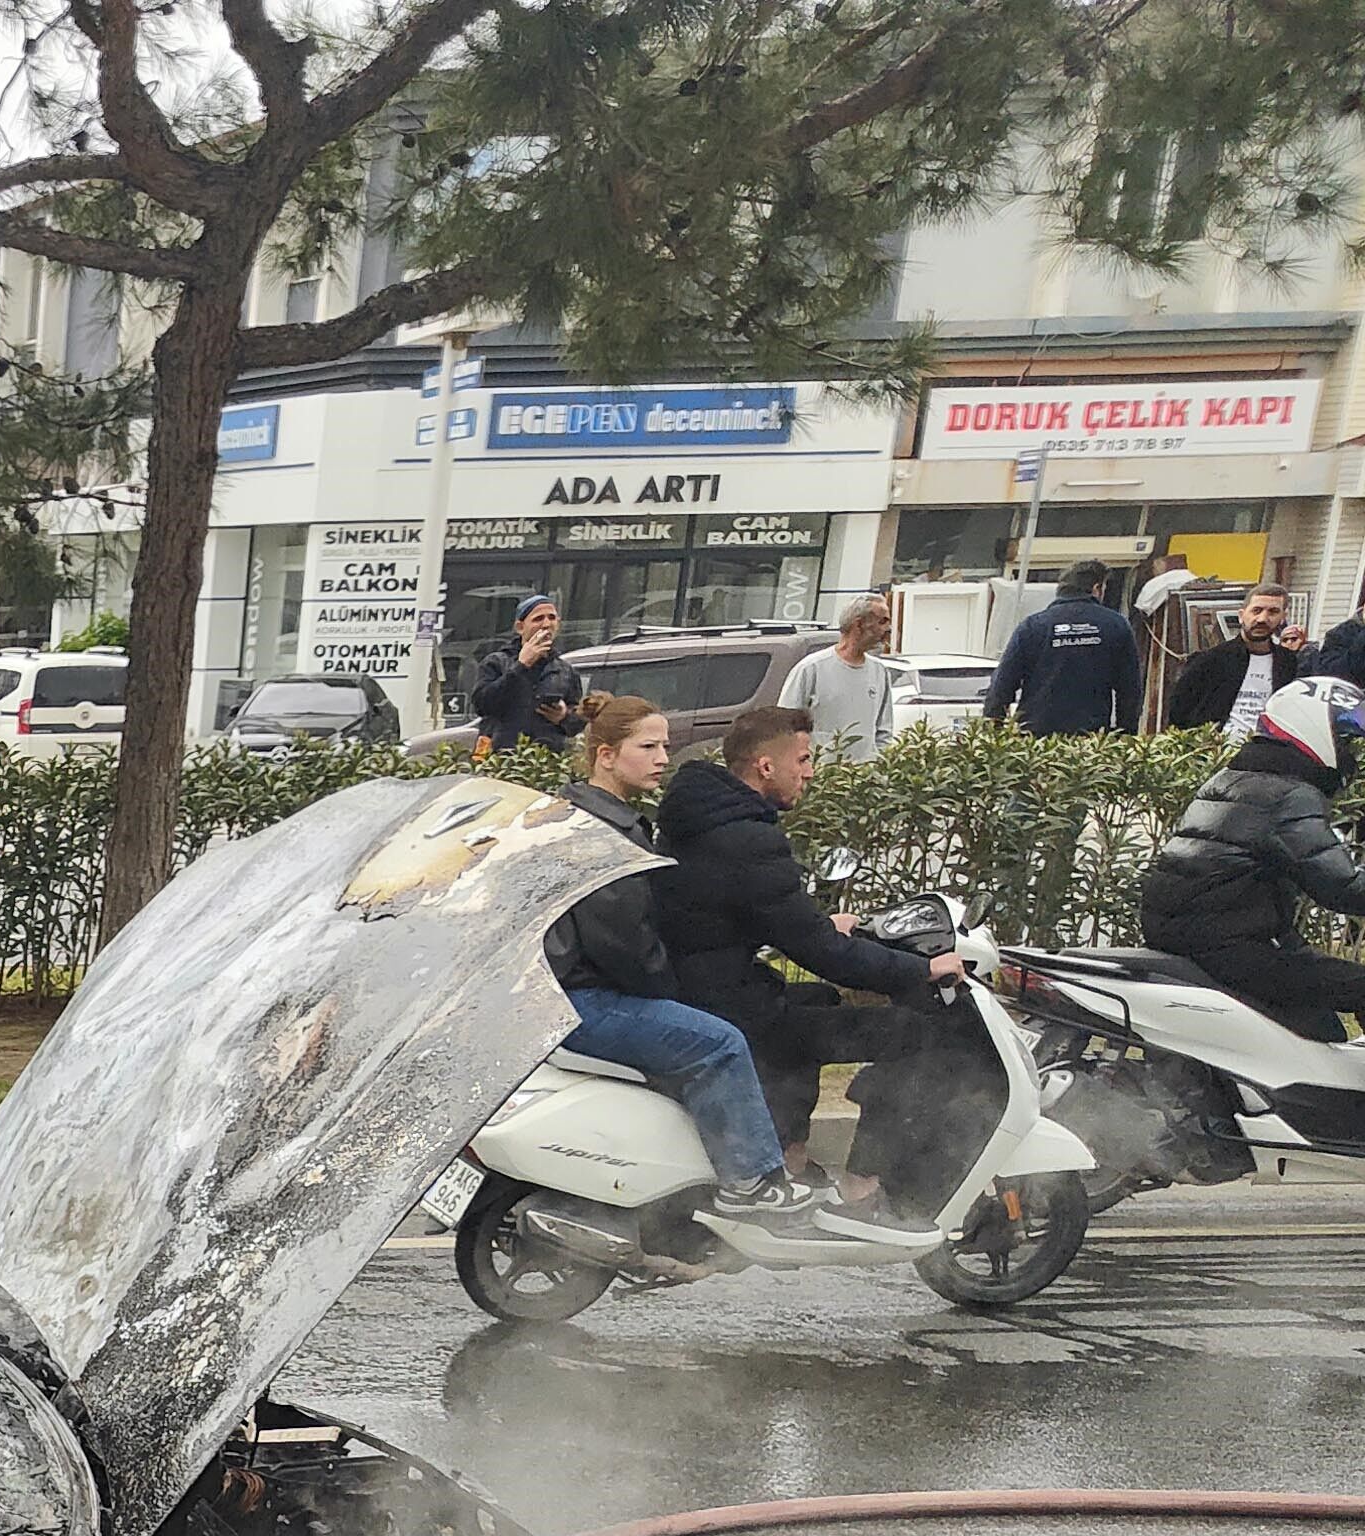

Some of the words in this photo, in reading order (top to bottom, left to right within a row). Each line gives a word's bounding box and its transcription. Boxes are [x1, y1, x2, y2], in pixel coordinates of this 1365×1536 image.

[497, 403, 638, 435] EGEPEN
[645, 400, 784, 433] deceuninck
[945, 400, 1073, 433] DORUK
[1081, 391, 1191, 437] ÇELİK
[1200, 395, 1296, 427] KAPI
[1043, 438, 1089, 452] 0535
[1095, 438, 1130, 452] 713
[1132, 437, 1158, 451] 78
[1163, 436, 1187, 450] 97
[543, 475, 621, 506] ADA
[635, 474, 721, 504] ARTI
[446, 518, 540, 535] TOMATİK
[569, 520, 674, 541] SİNEKLİK
[732, 516, 791, 530] CAM
[324, 527, 422, 545] SİNEKLİK
[445, 535, 525, 550] PANJUR
[706, 530, 812, 546] BALKON
[343, 563, 397, 577] CAM
[319, 577, 419, 593] BALKON
[317, 605, 416, 622] ALÜMİNYUM
[313, 641, 413, 658] OTOMATİK
[322, 659, 399, 673] PANJUR
[435, 1184, 461, 1213] 946
